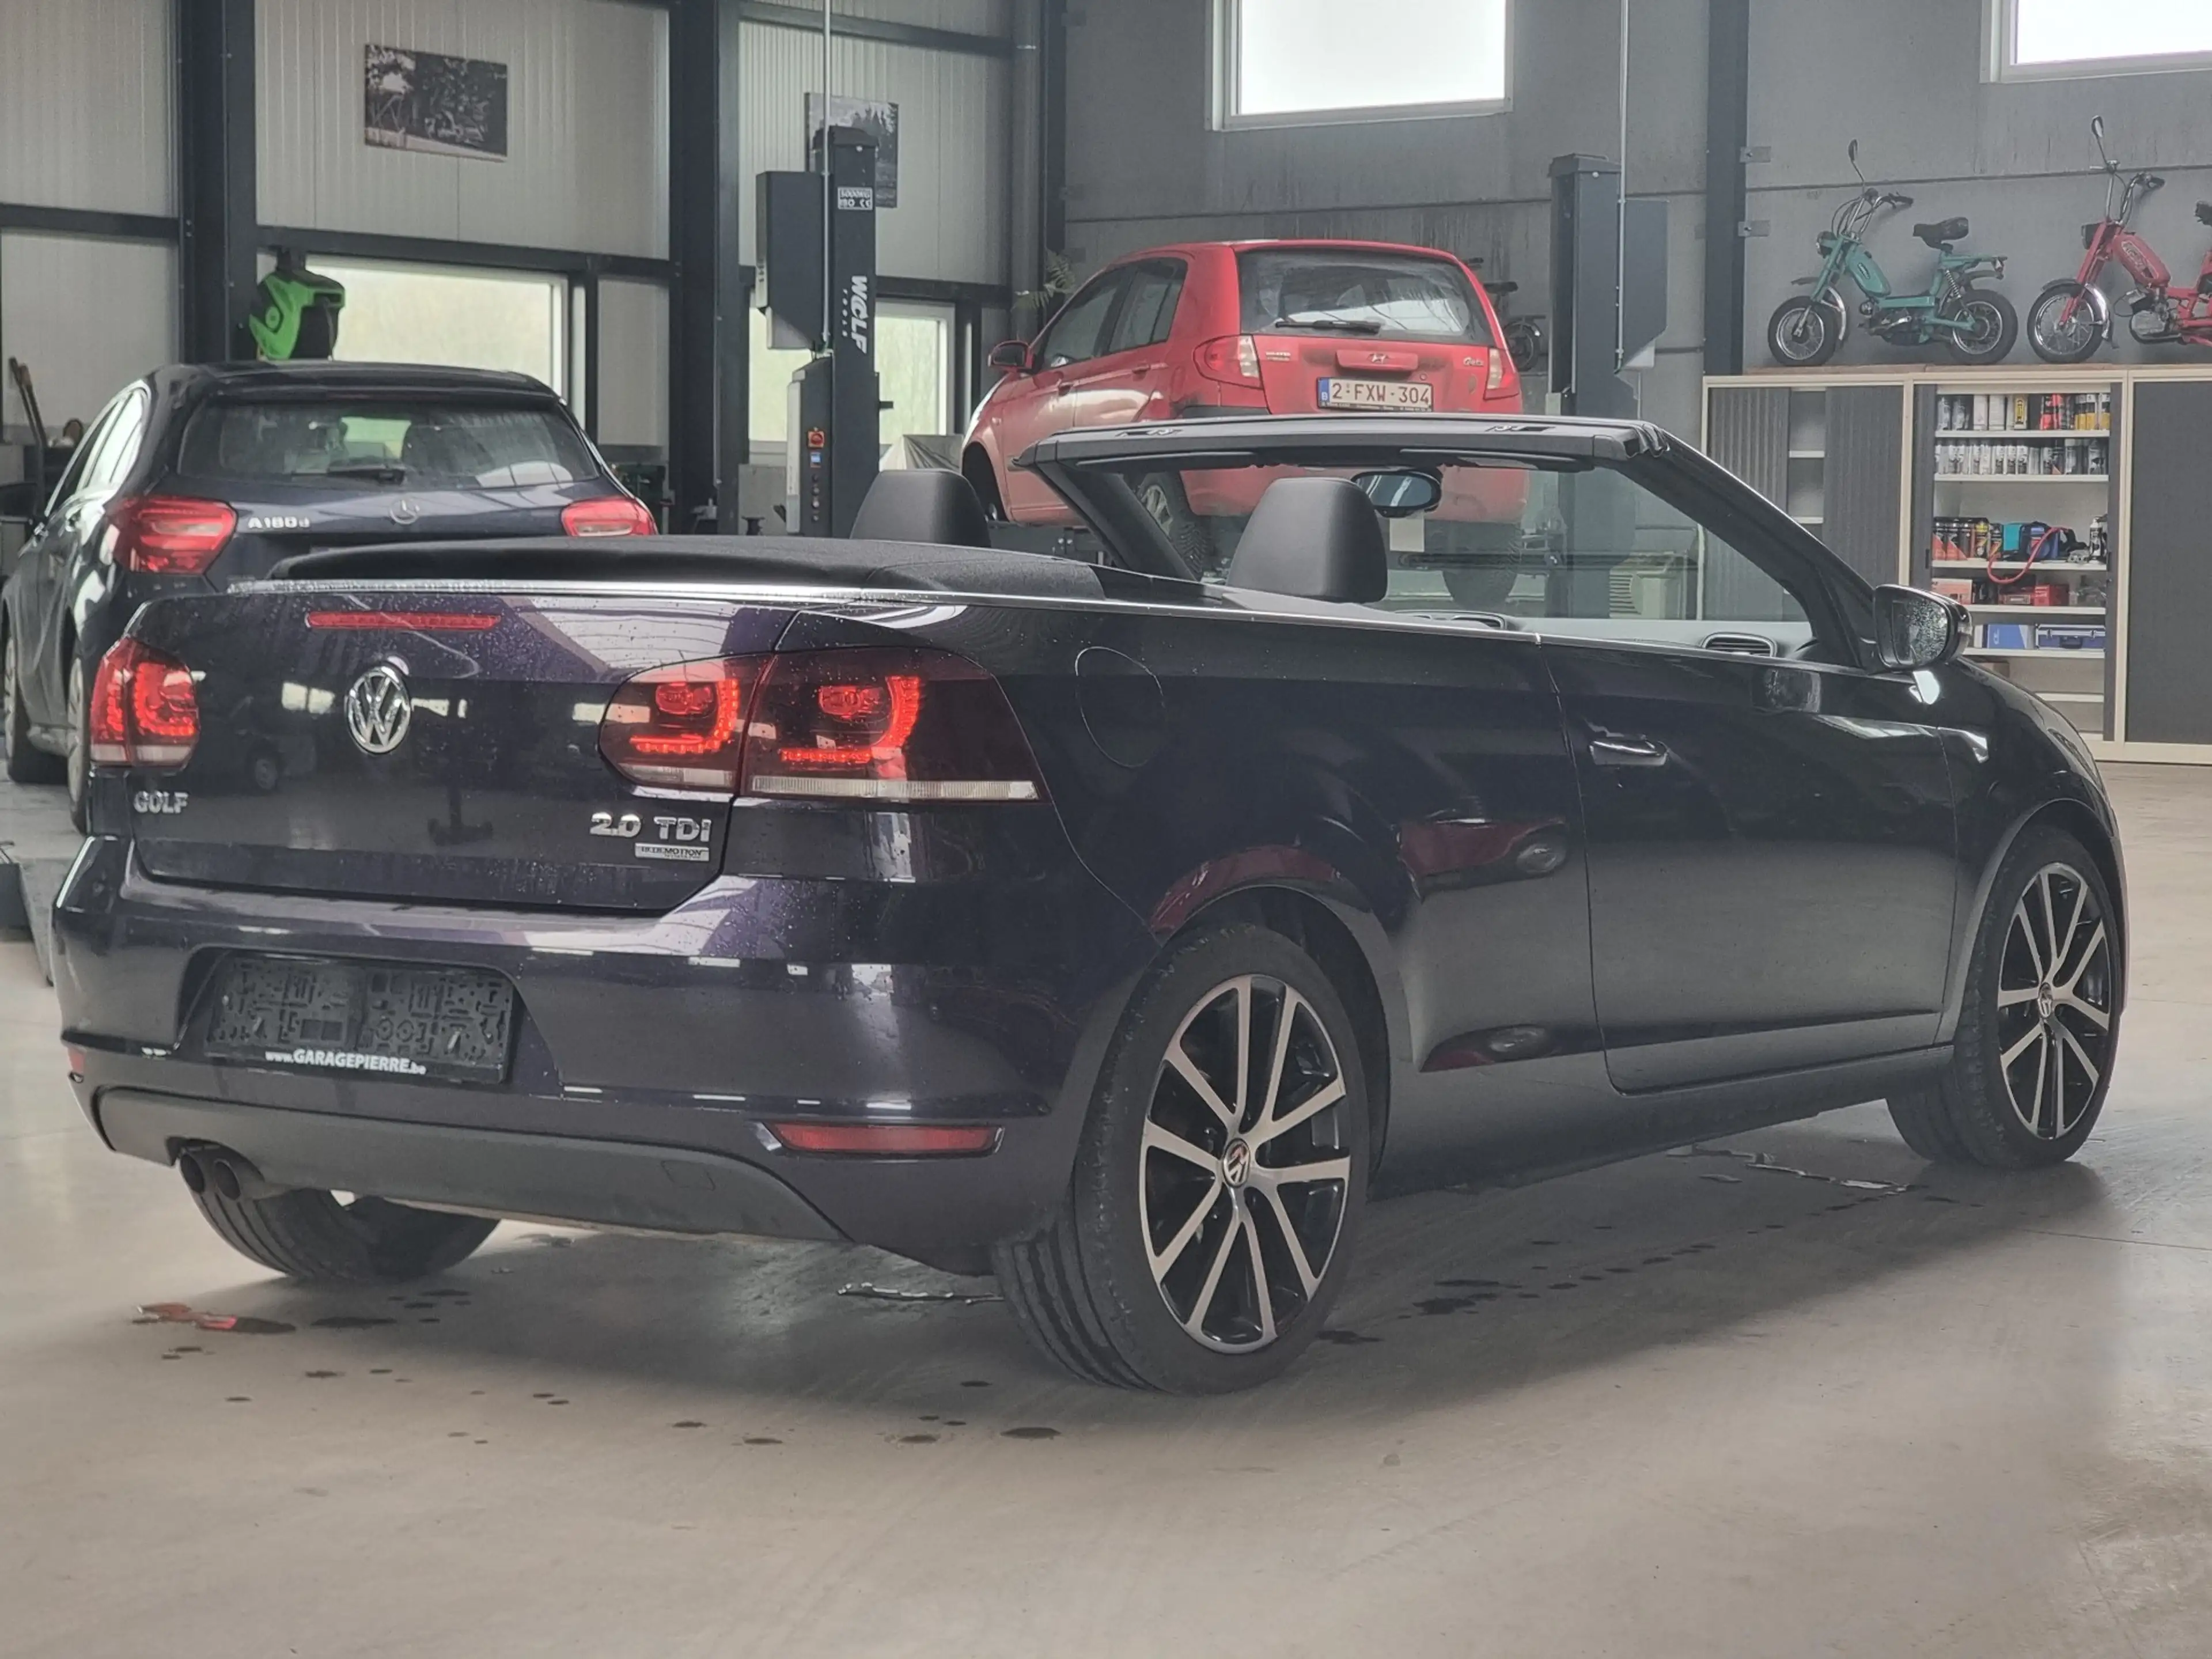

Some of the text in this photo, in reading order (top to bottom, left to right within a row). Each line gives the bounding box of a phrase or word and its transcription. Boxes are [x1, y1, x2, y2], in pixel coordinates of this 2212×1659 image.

[133, 790, 189, 813] GOLF
[589, 812, 642, 838] 2.0
[264, 1048, 427, 1075] www.GARAGEPIERRE.be
